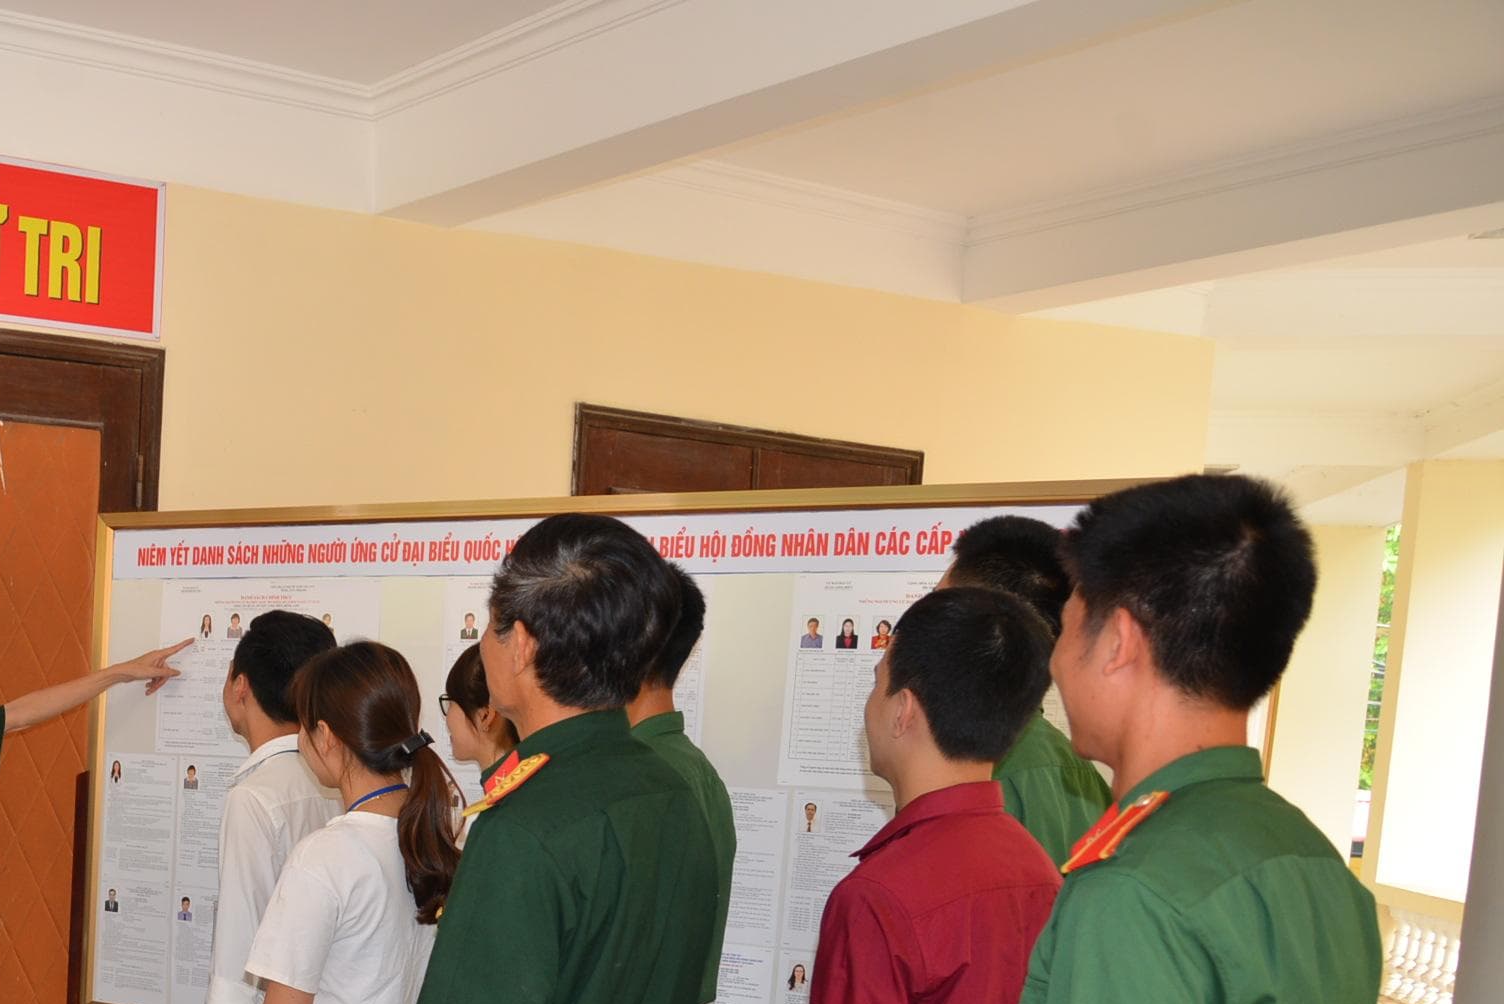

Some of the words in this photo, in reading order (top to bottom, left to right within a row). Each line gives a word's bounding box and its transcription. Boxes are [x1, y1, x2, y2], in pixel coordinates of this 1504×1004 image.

[18, 215, 102, 305] TRI
[137, 543, 167, 566] NIÊM
[170, 540, 190, 566] YẾT
[193, 544, 224, 565] DANH
[227, 541, 259, 565] SÁCH
[262, 539, 305, 564] NHỮNG
[308, 537, 347, 564] NGƯỜI
[350, 537, 378, 563] ỨNG
[381, 532, 401, 563] CỬ
[402, 540, 425, 566] ĐẠI
[428, 531, 460, 562] BIỂU
[463, 532, 501, 563] QUỐC
[661, 527, 695, 559] BIỂU
[699, 528, 728, 563] HỘI
[731, 526, 777, 558] ĐỒNG
[780, 527, 830, 557] NHÂN
[834, 527, 869, 556] DÂN
[874, 525, 910, 556] CÁC
[915, 521, 953, 556] CẤP
